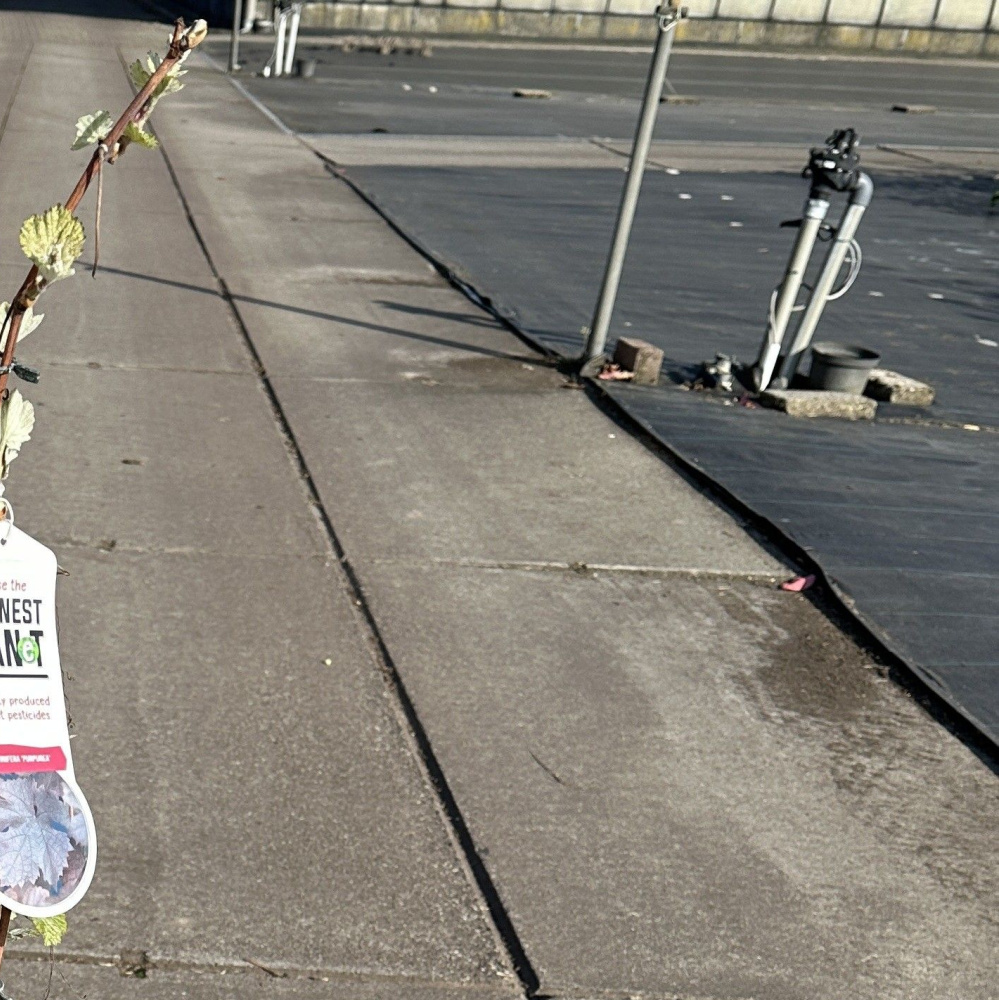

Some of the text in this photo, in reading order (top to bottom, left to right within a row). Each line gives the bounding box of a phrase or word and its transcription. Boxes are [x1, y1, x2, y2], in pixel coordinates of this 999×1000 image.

[11, 579, 27, 591] the
[9, 696, 51, 707] produced
[8, 709, 51, 721] pesticides
